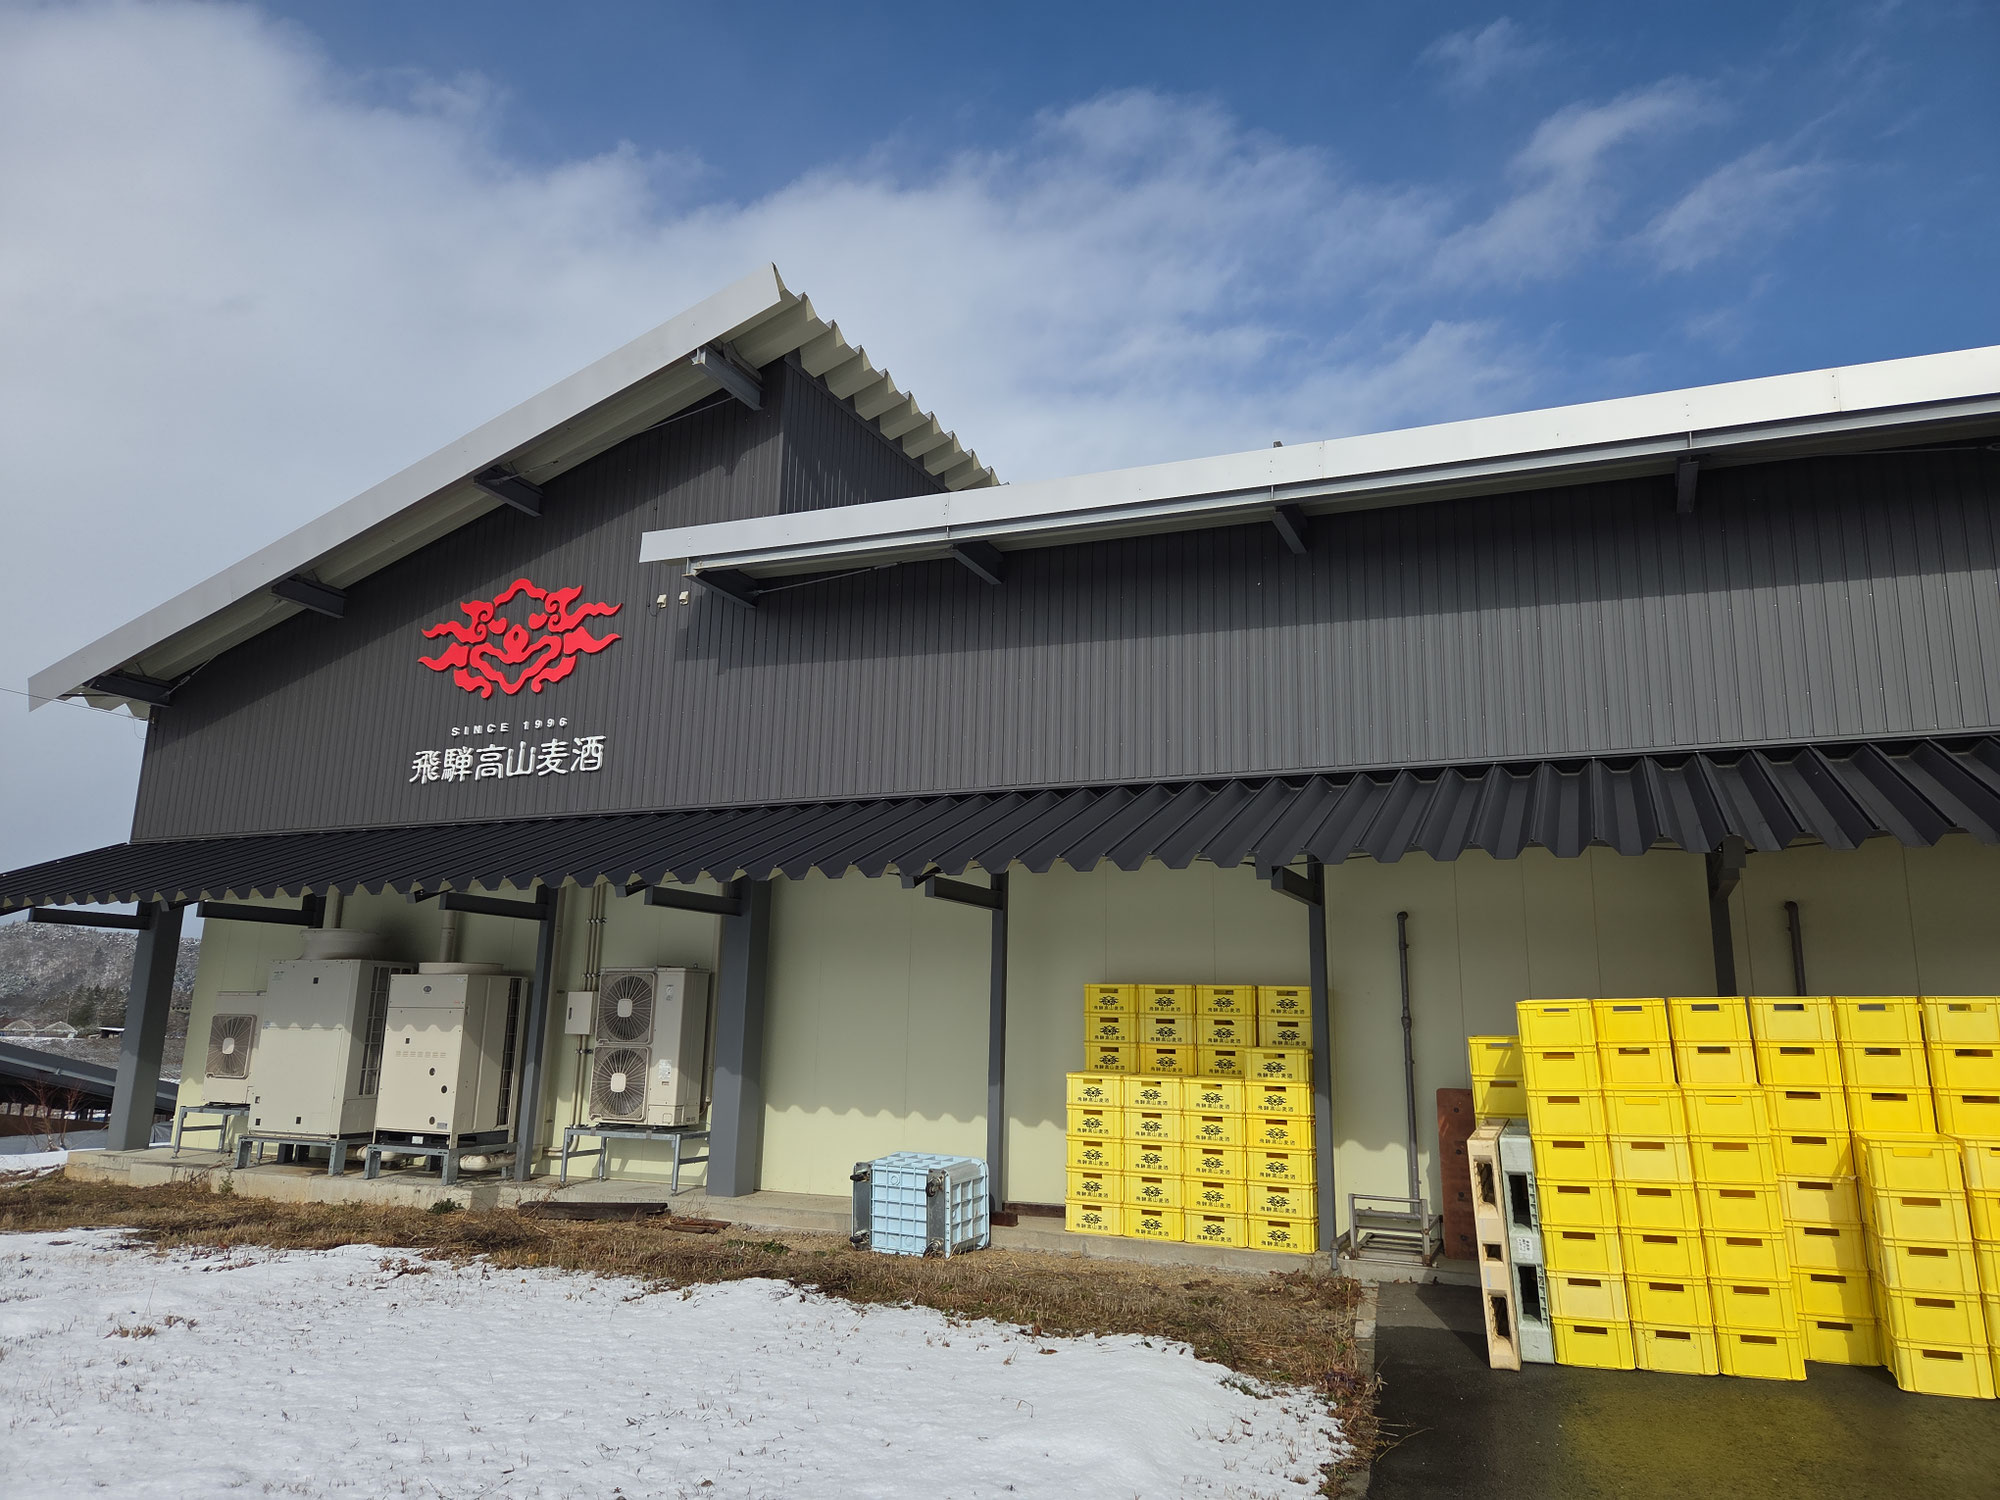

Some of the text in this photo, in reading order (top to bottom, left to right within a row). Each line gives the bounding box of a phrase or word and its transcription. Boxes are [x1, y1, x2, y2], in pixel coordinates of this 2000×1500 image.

[451, 717, 569, 737] SINCE 1996
[409, 735, 606, 785] 飛騨高山麦酒
